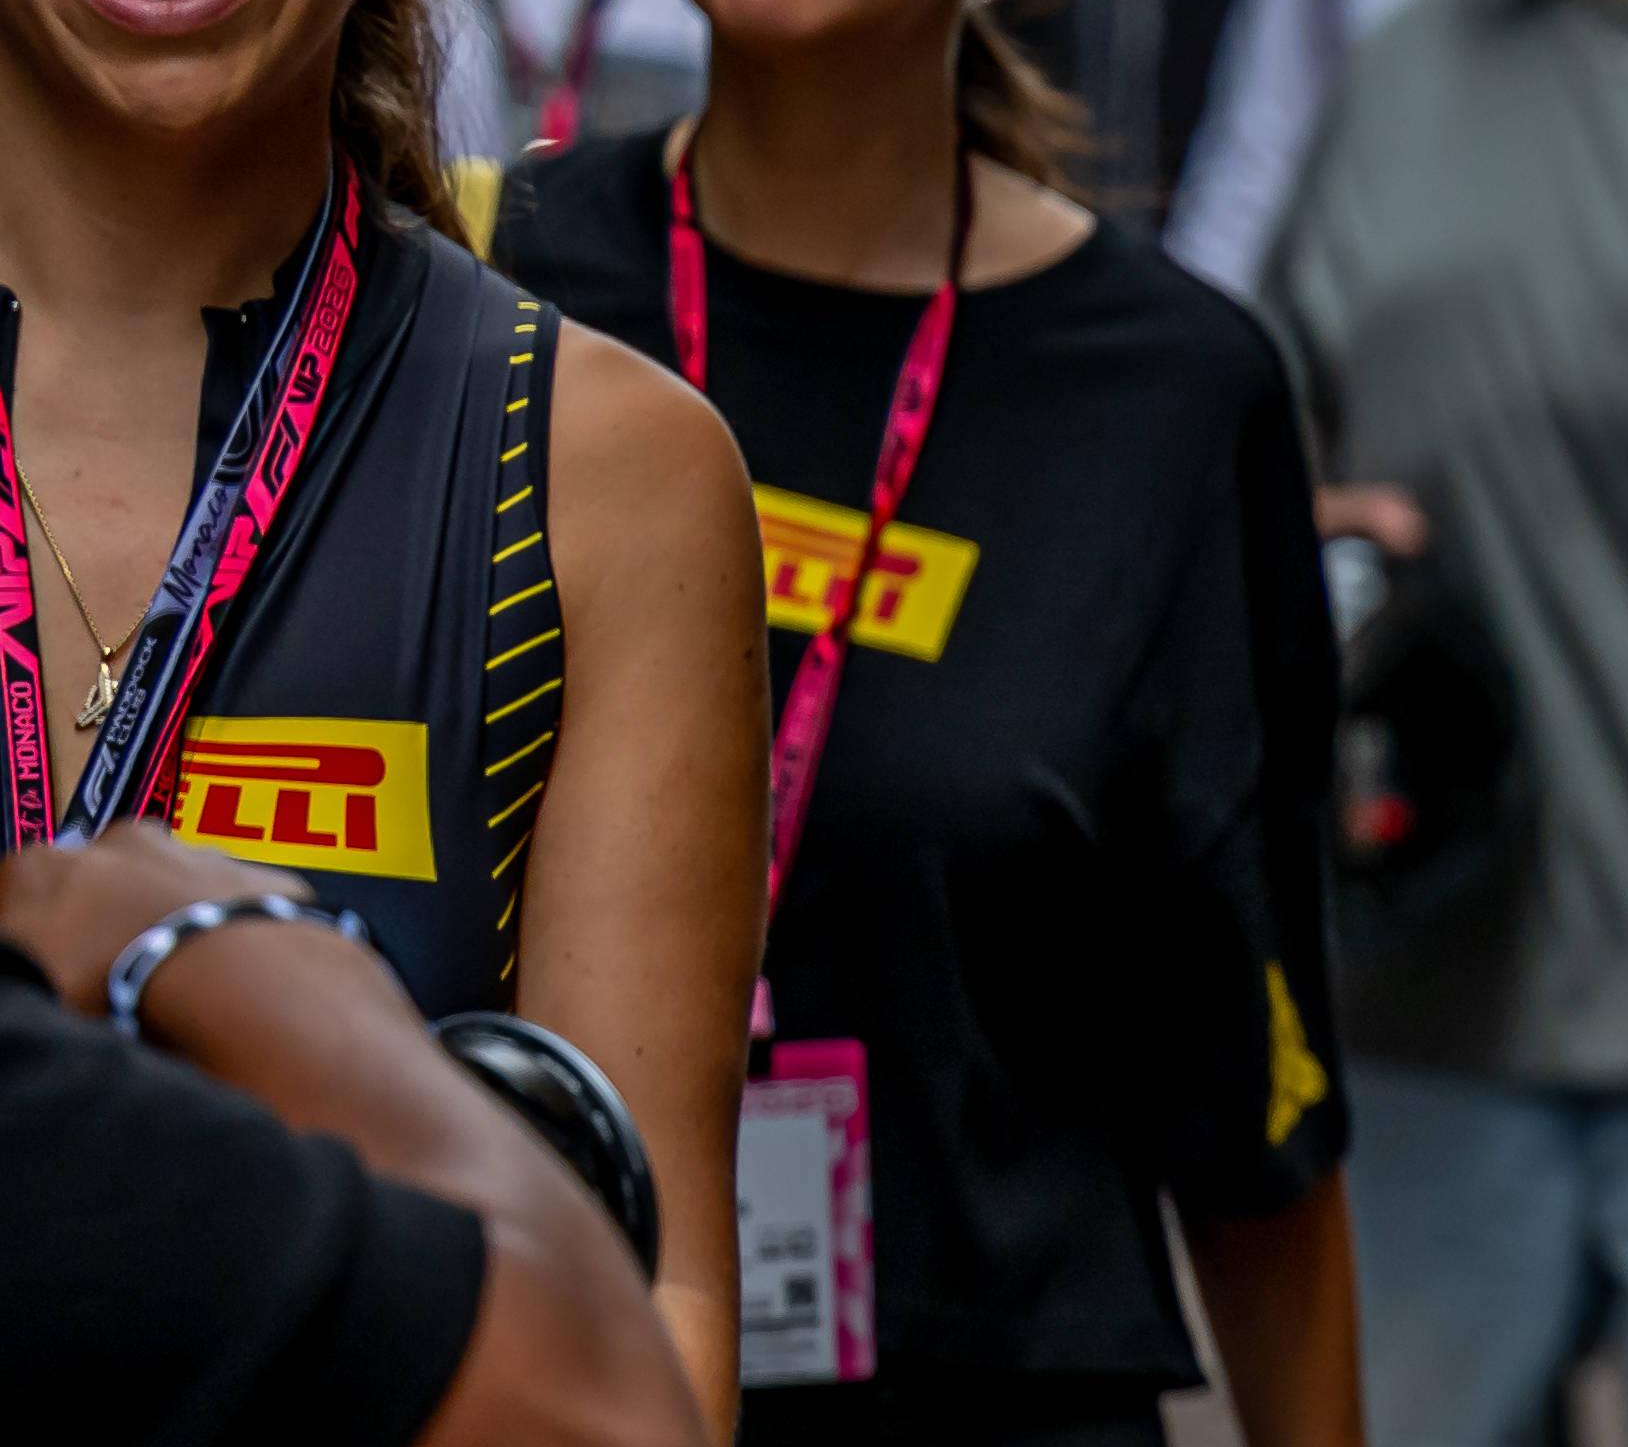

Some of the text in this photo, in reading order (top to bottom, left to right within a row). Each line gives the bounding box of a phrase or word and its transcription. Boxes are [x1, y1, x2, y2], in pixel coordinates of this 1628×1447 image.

[287, 353, 323, 403] VIP
[162, 485, 228, 608] Monaco
[10, 680, 40, 781] MONACO
